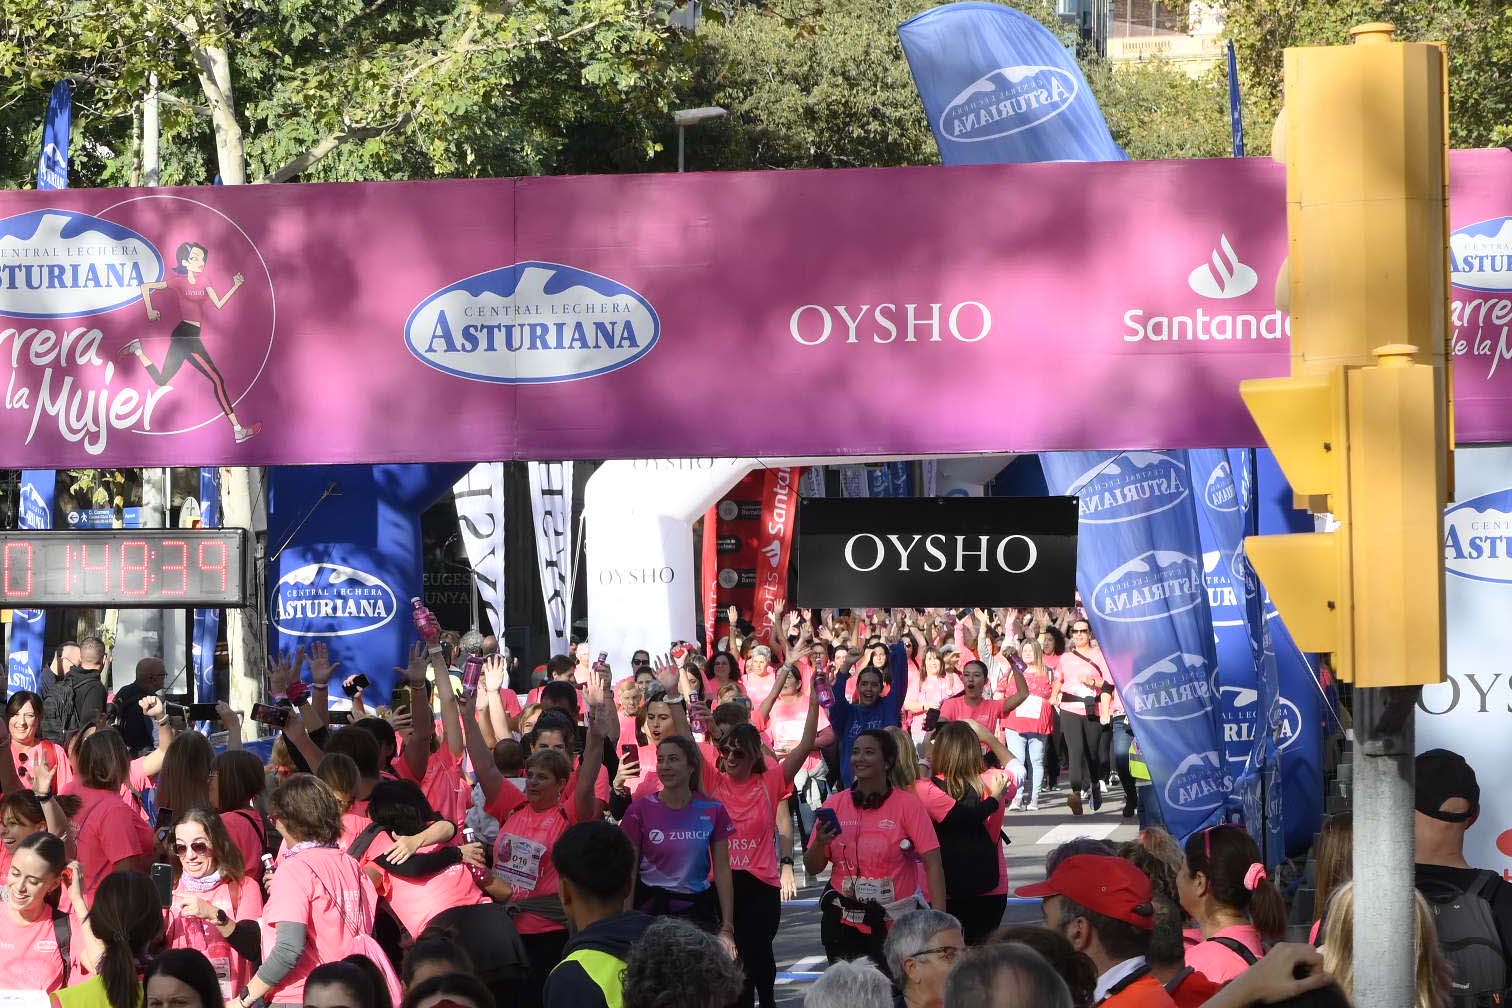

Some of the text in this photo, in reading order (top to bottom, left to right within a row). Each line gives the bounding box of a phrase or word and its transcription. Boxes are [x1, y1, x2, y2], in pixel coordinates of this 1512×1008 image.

[67, 245, 139, 257] LECHERA
[464, 303, 632, 317] CENTRAL LECHERA
[425, 309, 641, 354] ASTURIANA
[790, 301, 993, 346] OYSHO
[5, 371, 30, 411] la
[25, 361, 174, 455] Mujer
[844, 532, 1038, 574] OYSHO
[598, 565, 676, 585] OYSHO
[286, 588, 330, 597] CENTRAL
[274, 594, 388, 621] ASTURIANA
[669, 830, 710, 841] ZURICH
